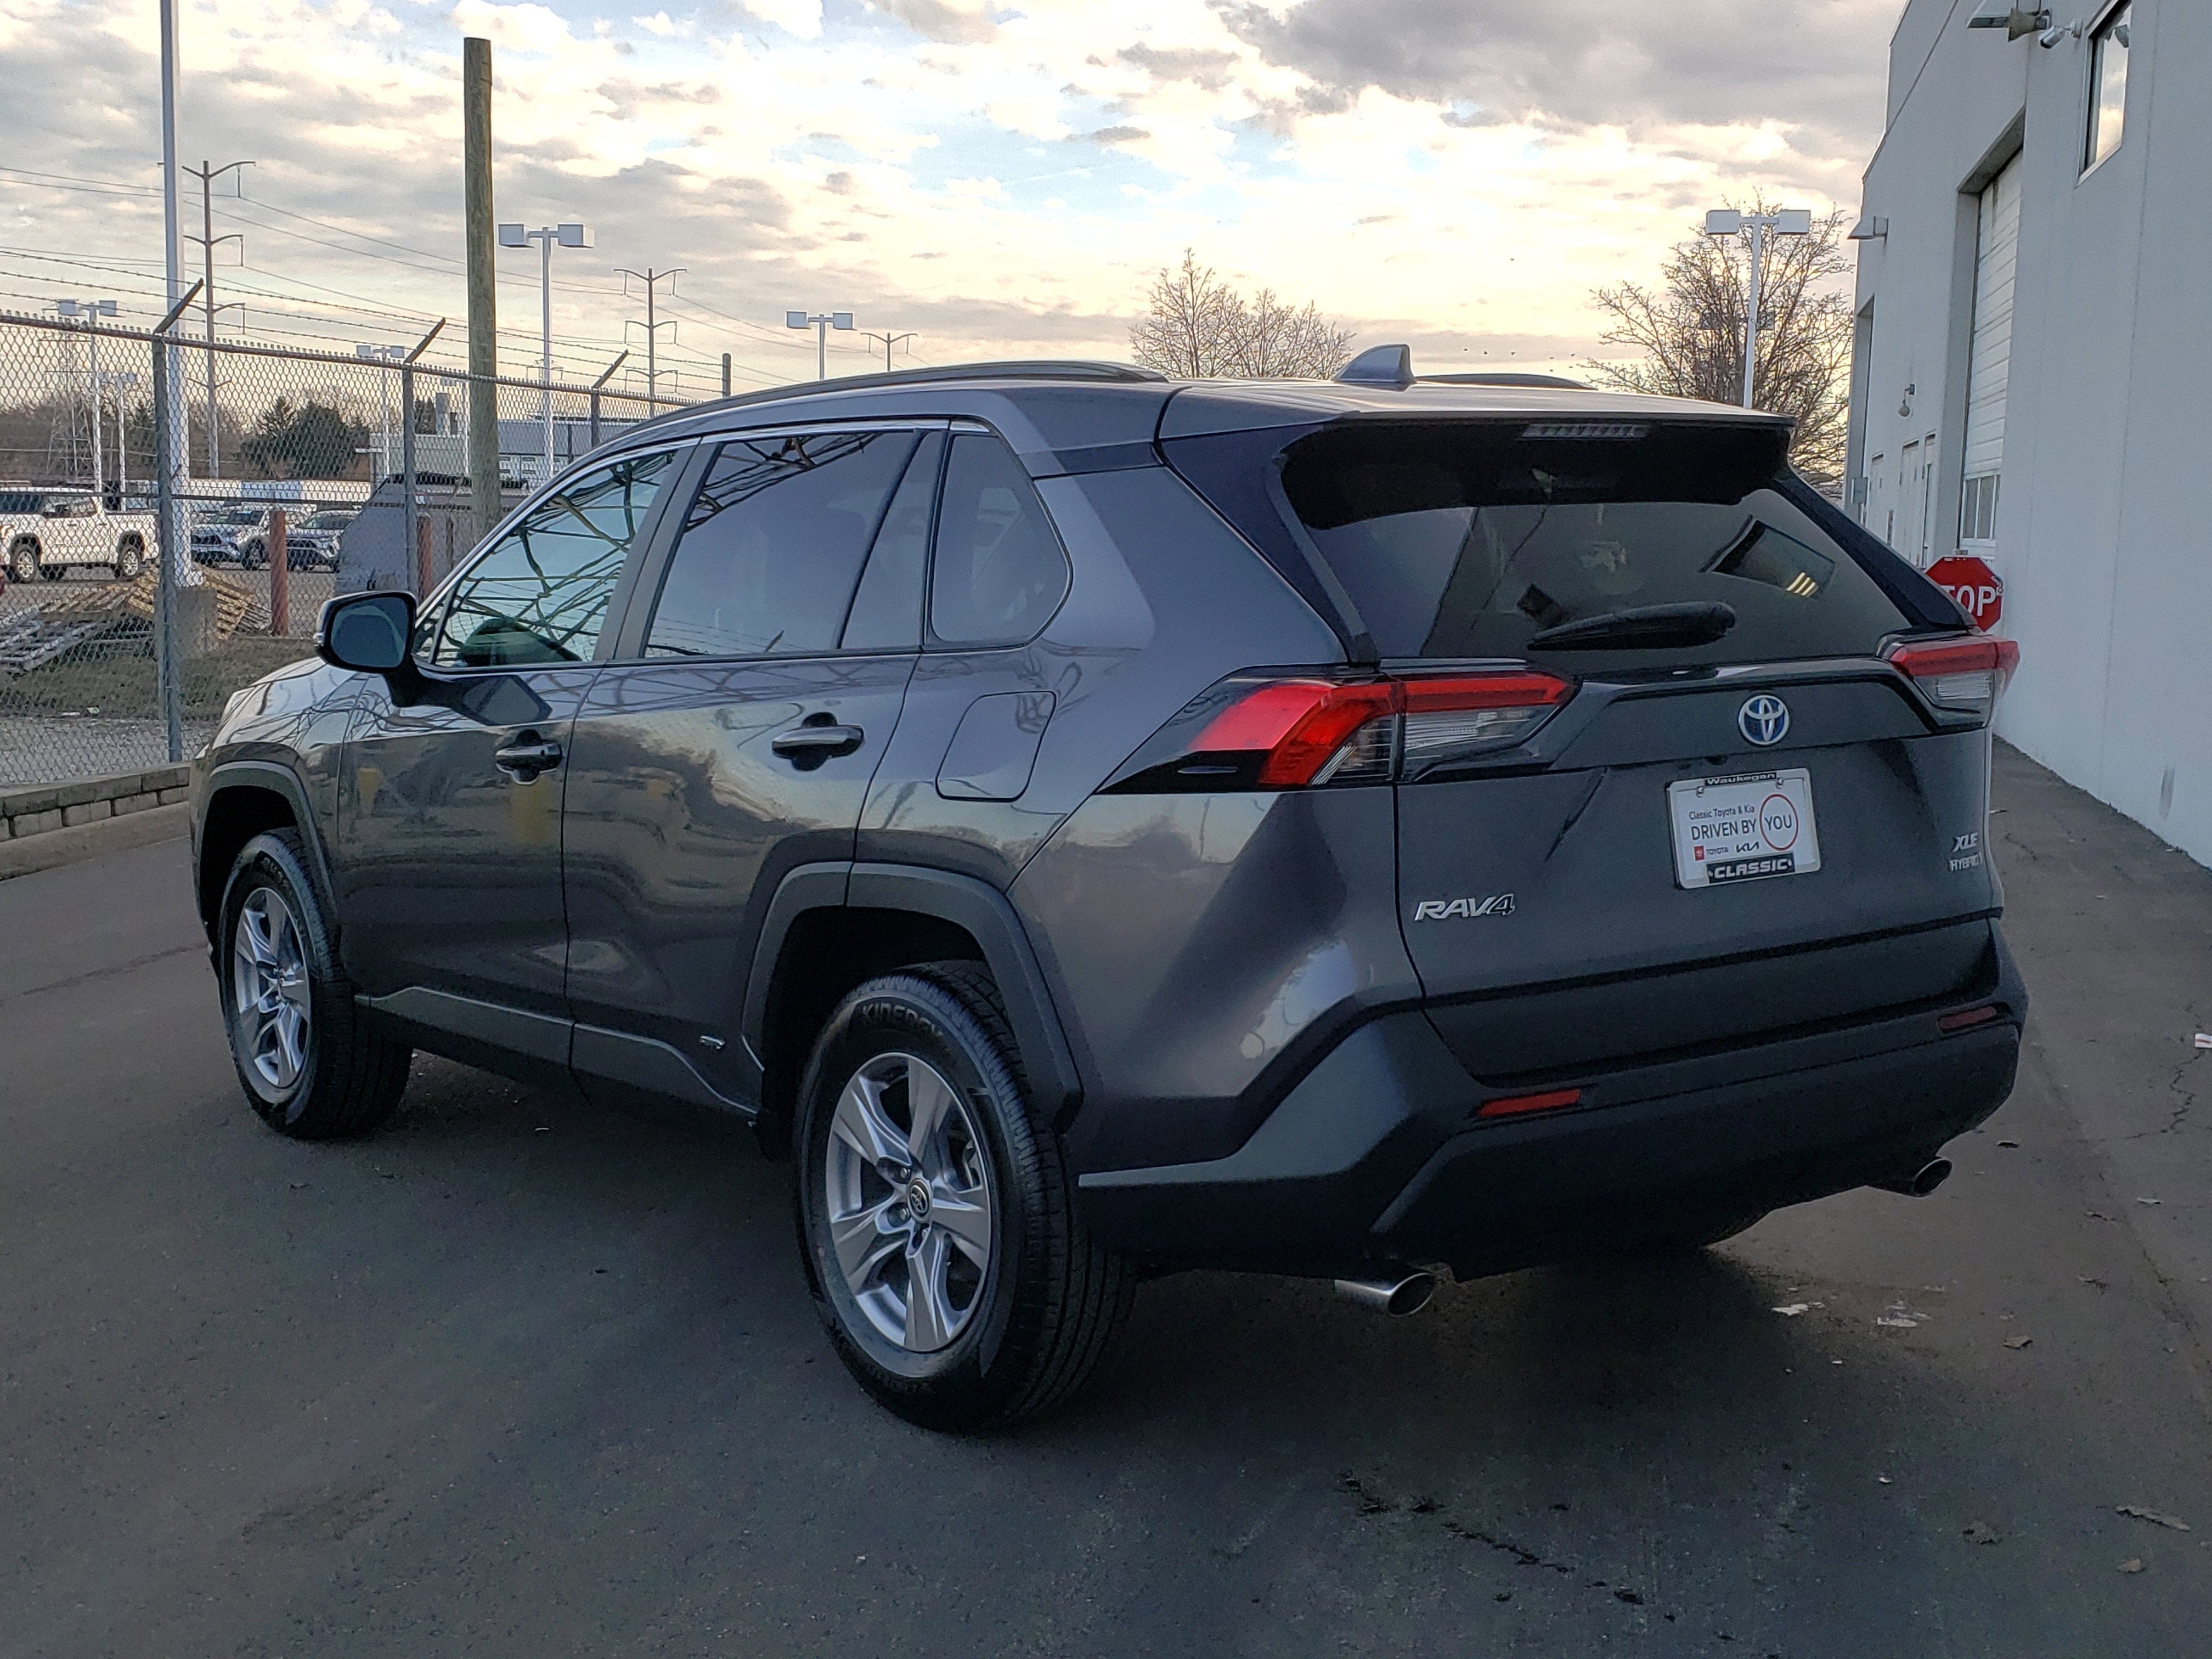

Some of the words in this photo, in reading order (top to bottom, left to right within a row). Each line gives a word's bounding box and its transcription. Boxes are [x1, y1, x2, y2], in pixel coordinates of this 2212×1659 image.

[1940, 585, 1996, 616] OP
[1707, 774, 1775, 785] Waukegan
[1689, 811, 1712, 820] Classic
[1713, 808, 1736, 817] Toyota
[1737, 806, 1743, 814] &
[1743, 805, 1755, 814] Kia
[1691, 821, 1739, 840] DRIVEN
[1741, 819, 1757, 834] BY
[1764, 815, 1792, 831] YOU
[1706, 847, 1729, 855] TOYOTA
[1952, 832, 1978, 852] XLE
[1714, 859, 1788, 878] CLASSIC
[1414, 894, 1515, 921] RAV4
